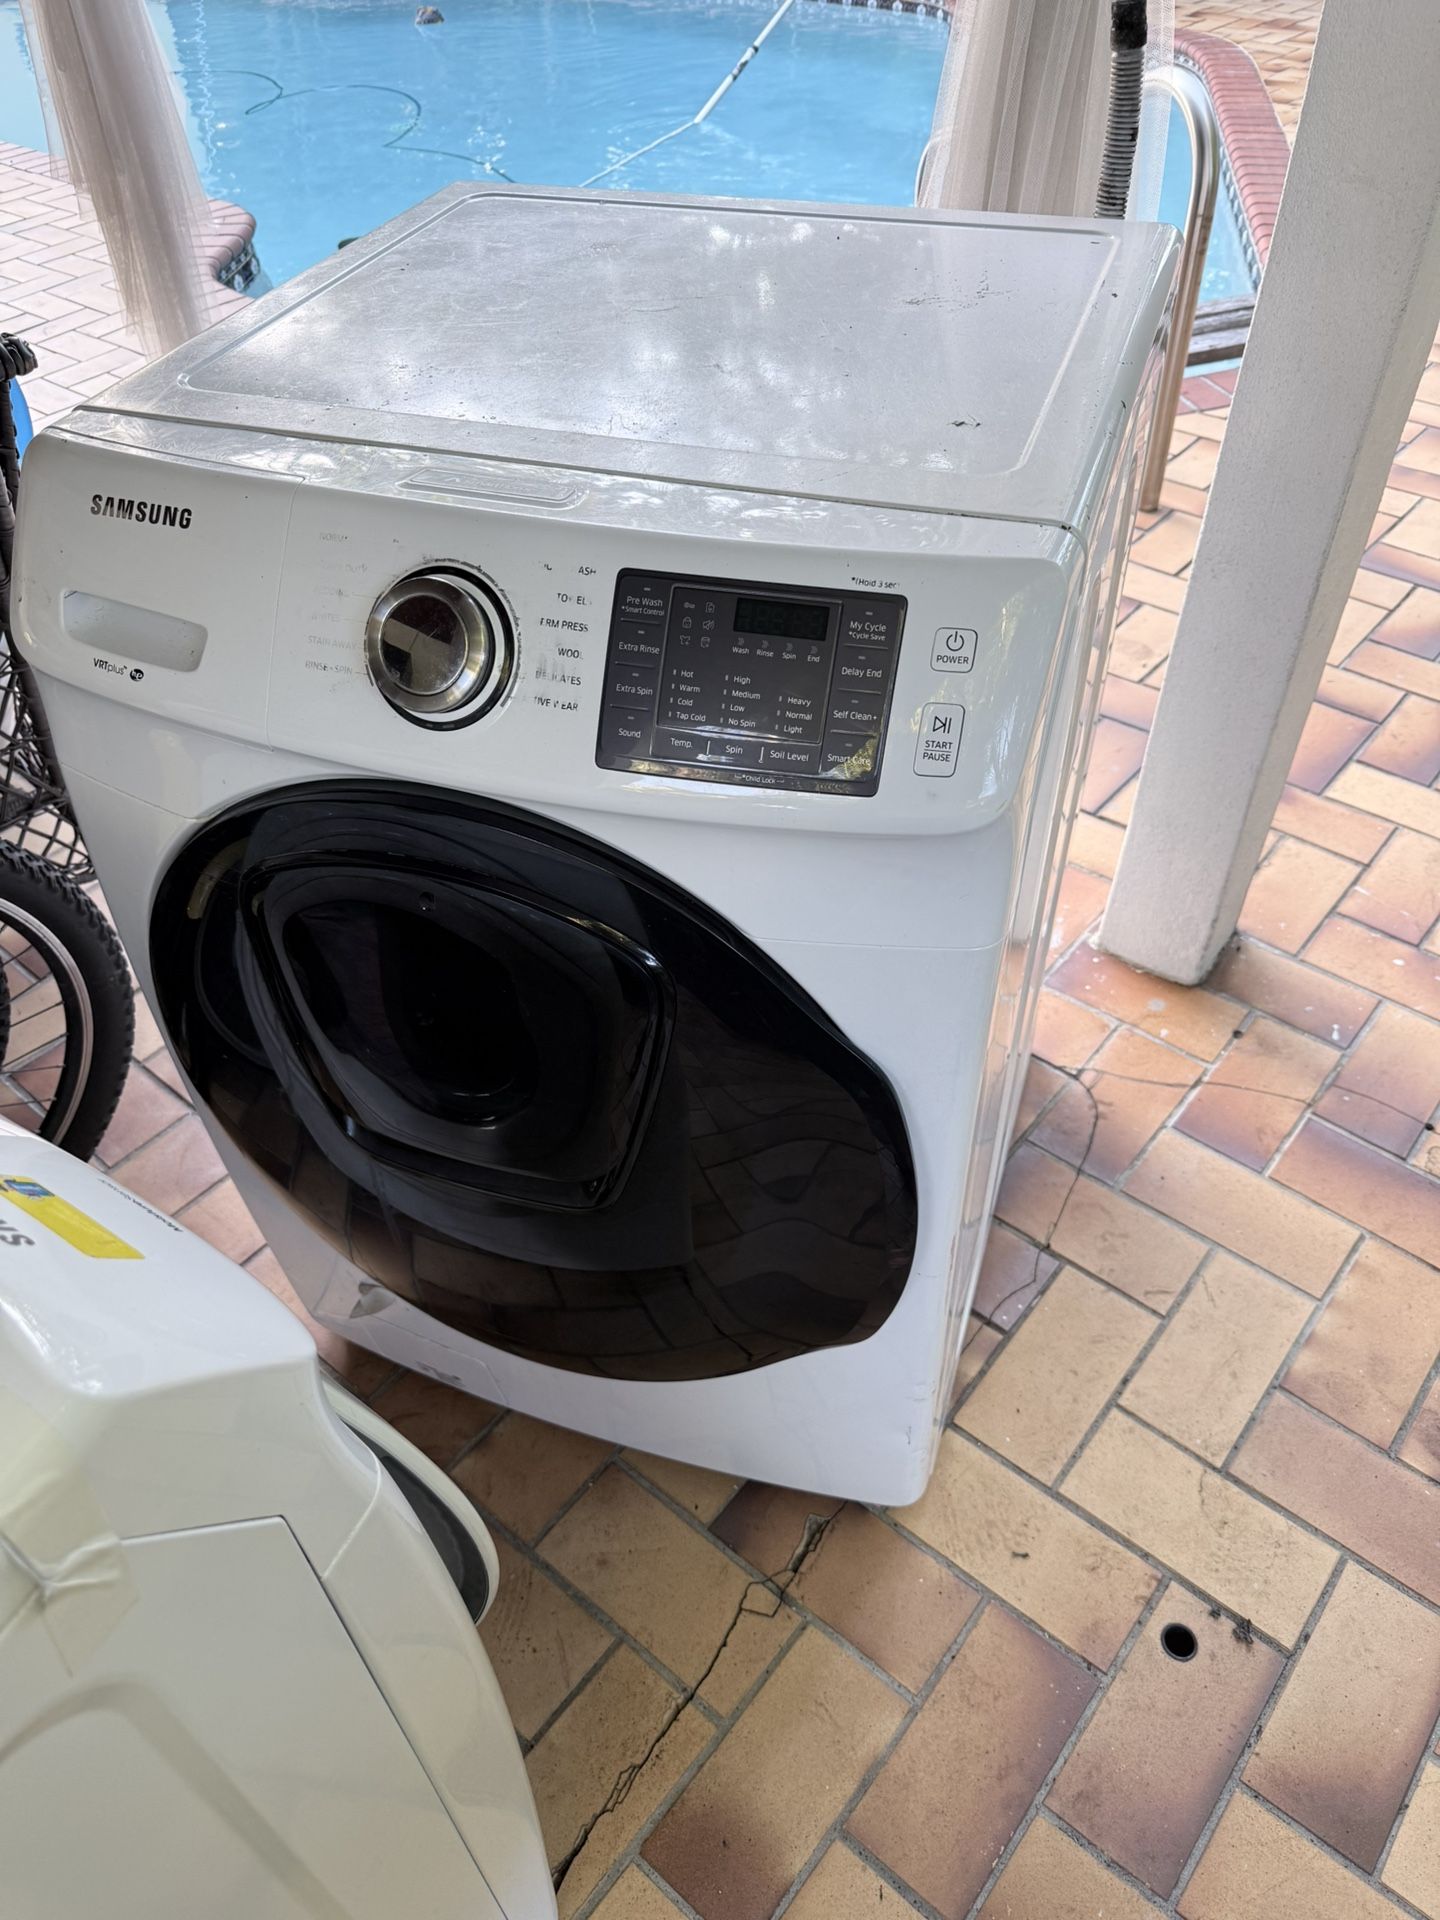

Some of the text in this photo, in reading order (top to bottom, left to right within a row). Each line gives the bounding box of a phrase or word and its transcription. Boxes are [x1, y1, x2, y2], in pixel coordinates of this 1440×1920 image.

[90, 494, 192, 529] SAMSUNG
[627, 595, 663, 607] Pre Wash
[643, 607, 664, 617] Control
[561, 621, 589, 633] PRESS
[849, 620, 887, 633] My Cycle
[870, 633, 886, 641] Save
[618, 641, 660, 654] Extra Rinse
[732, 646, 750, 655] Wash
[756, 648, 774, 658] Rinse
[782, 651, 797, 660] Spin
[807, 654, 821, 663] End
[936, 655, 969, 665] POWER
[680, 669, 694, 678] Hot
[841, 666, 882, 679] Delay End
[733, 675, 751, 685] High
[616, 683, 653, 696] Extra Spin
[679, 684, 701, 693] Warm
[731, 689, 761, 700] Medium
[677, 697, 694, 707] Cold
[787, 696, 811, 707] Heavy
[729, 703, 745, 713] Low
[676, 711, 707, 722] Tap Cold
[785, 711, 813, 721] Normal
[833, 709, 849, 719] Self
[728, 717, 756, 728] No Spin
[618, 728, 641, 738] Sound
[783, 724, 803, 734] Light
[670, 737, 693, 749] Temp.
[925, 740, 953, 750] START
[725, 744, 743, 755] Spin
[769, 749, 809, 762] Soil Level
[827, 753, 872, 767] Smart Care
[923, 752, 951, 762] PAUSE
[762, 776, 776, 784] Lock
